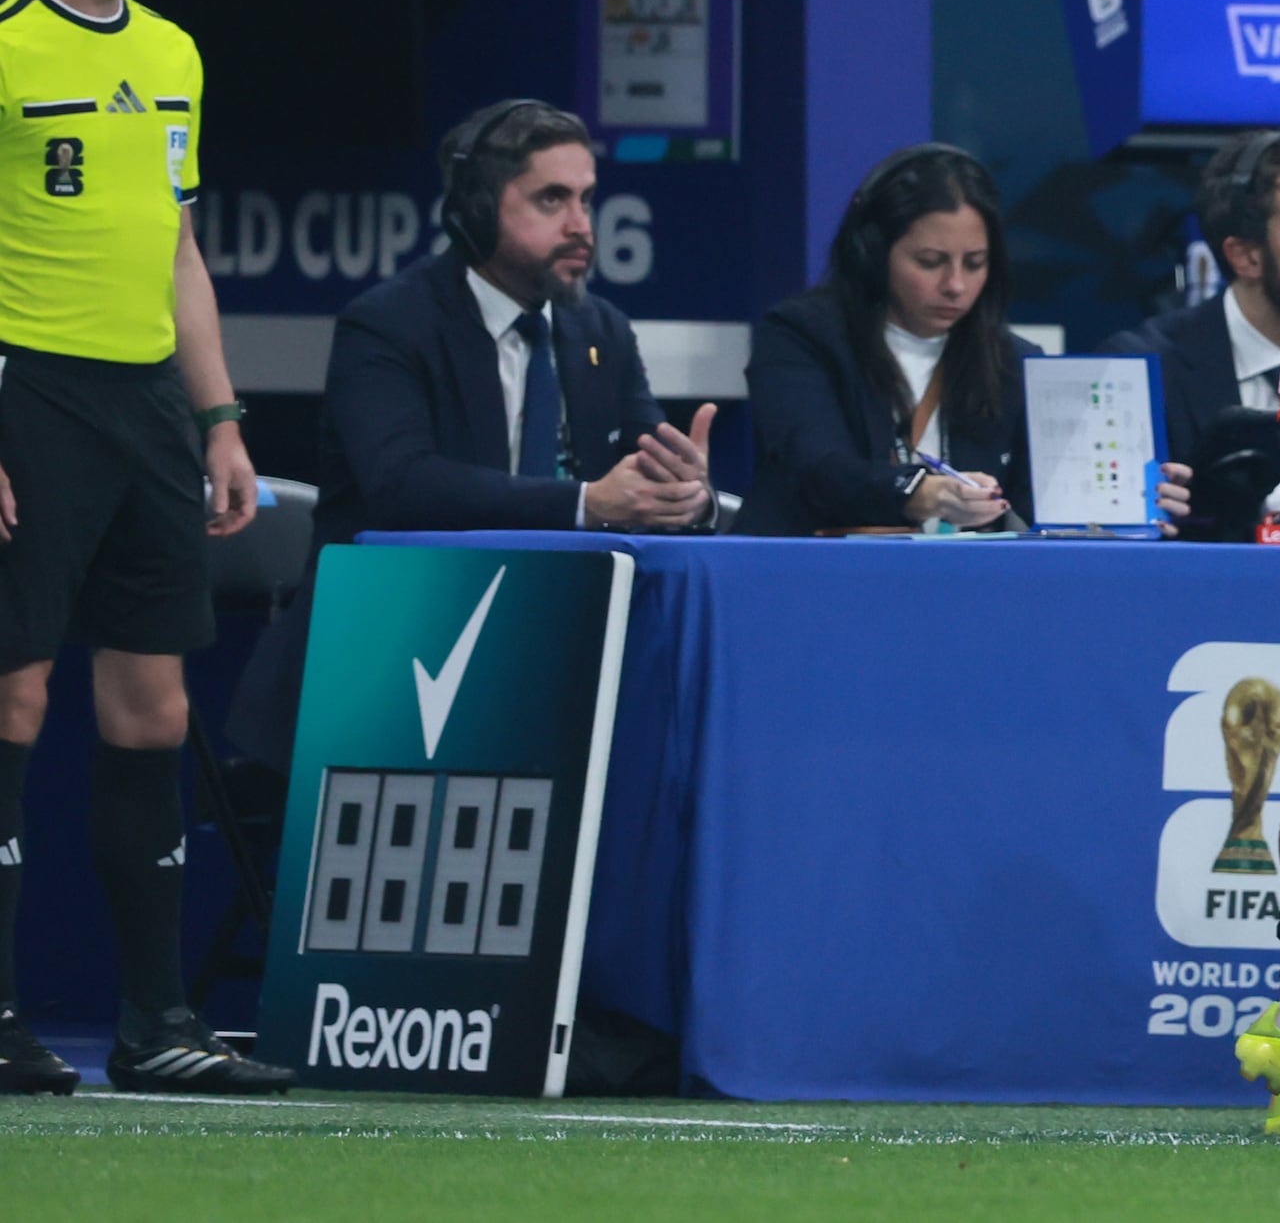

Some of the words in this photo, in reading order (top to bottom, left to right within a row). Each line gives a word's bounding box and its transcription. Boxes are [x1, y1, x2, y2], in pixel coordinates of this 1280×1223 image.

[292, 189, 421, 279] CUP
[1206, 888, 1280, 920] FIFA
[1152, 960, 1260, 988] WORLD
[307, 982, 493, 1073] Rexona
[1147, 993, 1276, 1038] 202
